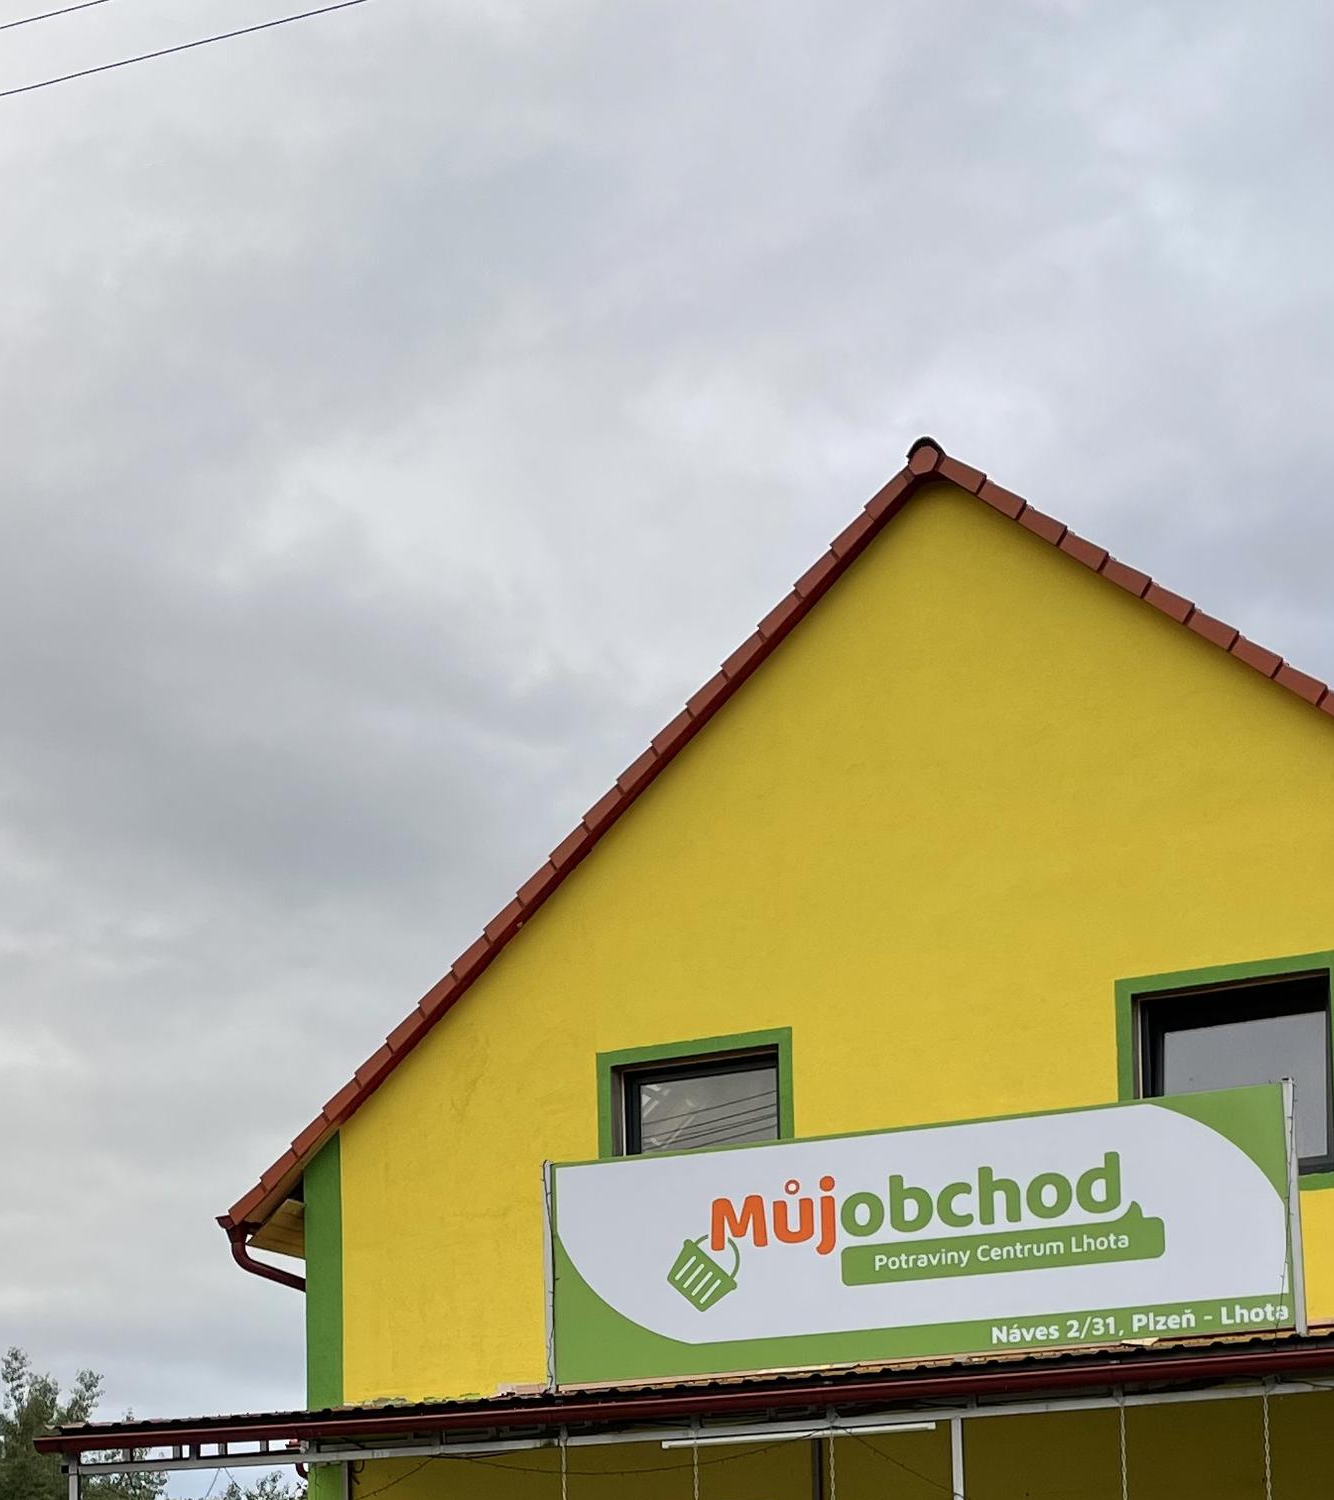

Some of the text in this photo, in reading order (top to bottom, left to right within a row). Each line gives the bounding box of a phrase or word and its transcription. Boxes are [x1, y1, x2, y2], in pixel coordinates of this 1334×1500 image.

[874, 1231, 1130, 1272] Potraviny Centrum Lhota
[991, 1324, 1060, 1345] Náves
[1066, 1315, 1125, 1339] 2/31,
[1132, 1308, 1196, 1333] Plzeň
[1220, 1302, 1290, 1325] Lhota
